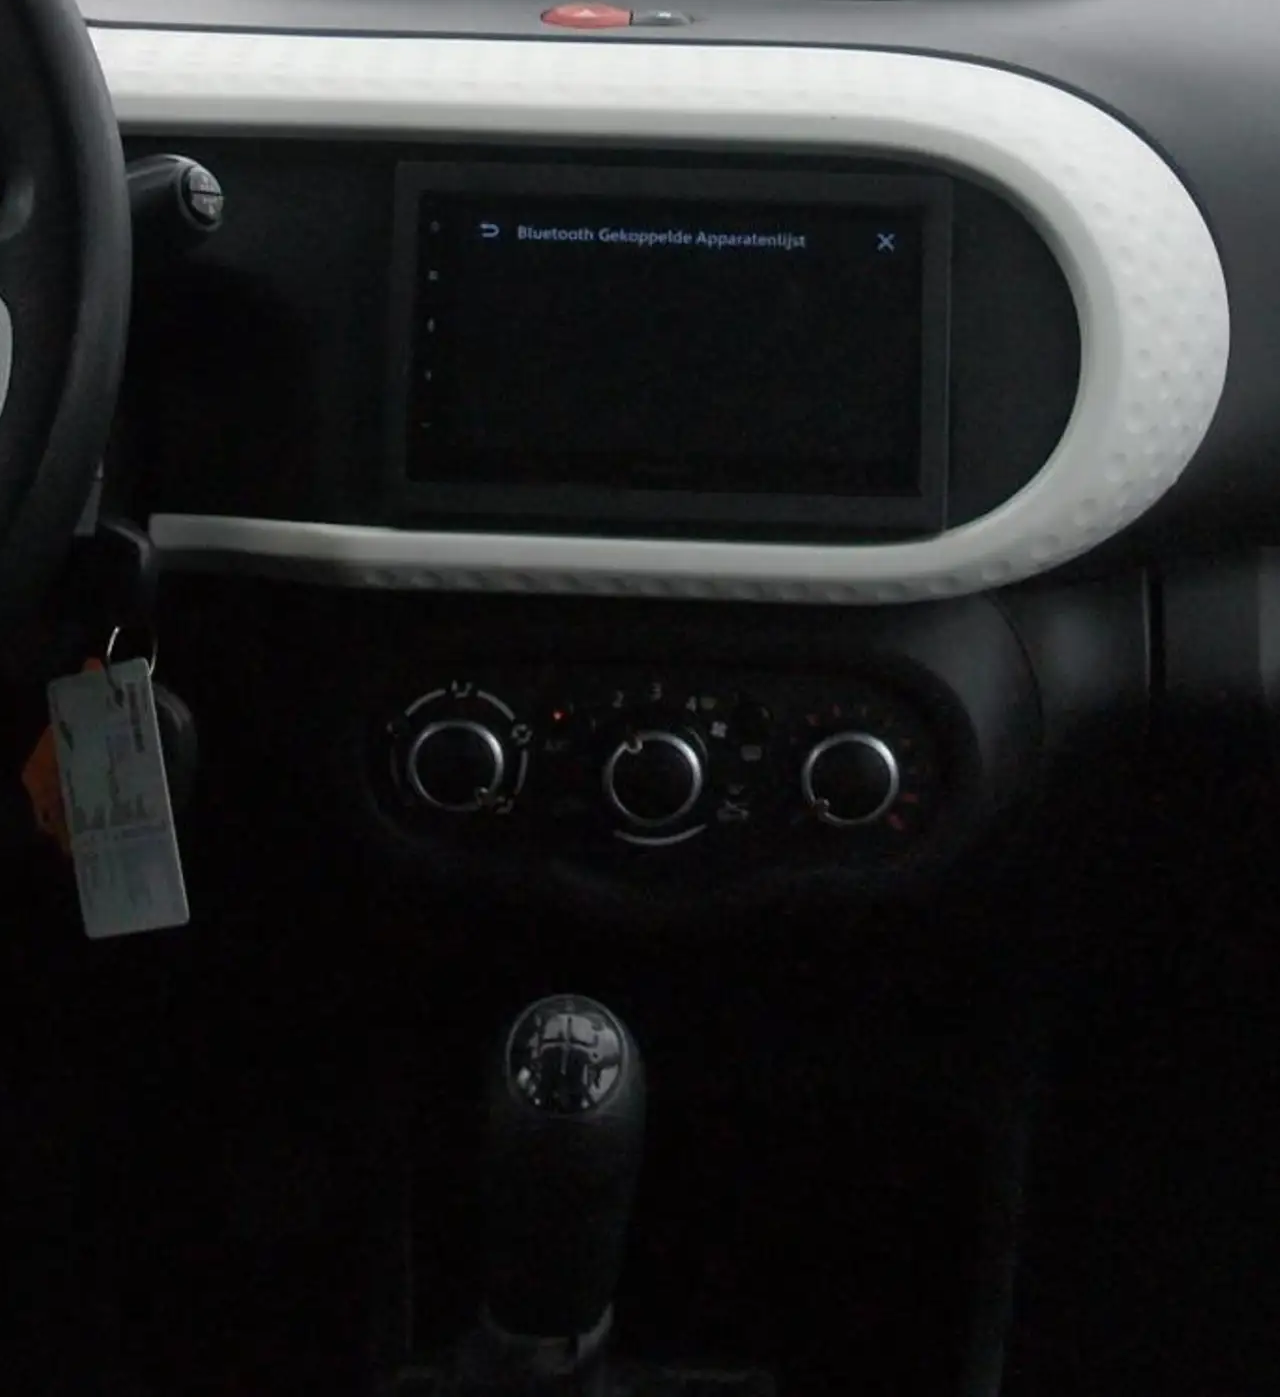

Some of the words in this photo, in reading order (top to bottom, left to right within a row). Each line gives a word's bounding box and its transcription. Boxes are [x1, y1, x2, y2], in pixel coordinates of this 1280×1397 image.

[516, 224, 594, 241] Bluetooth
[598, 226, 693, 247] Gekoppelde
[694, 230, 807, 251] Apparatenlijst
